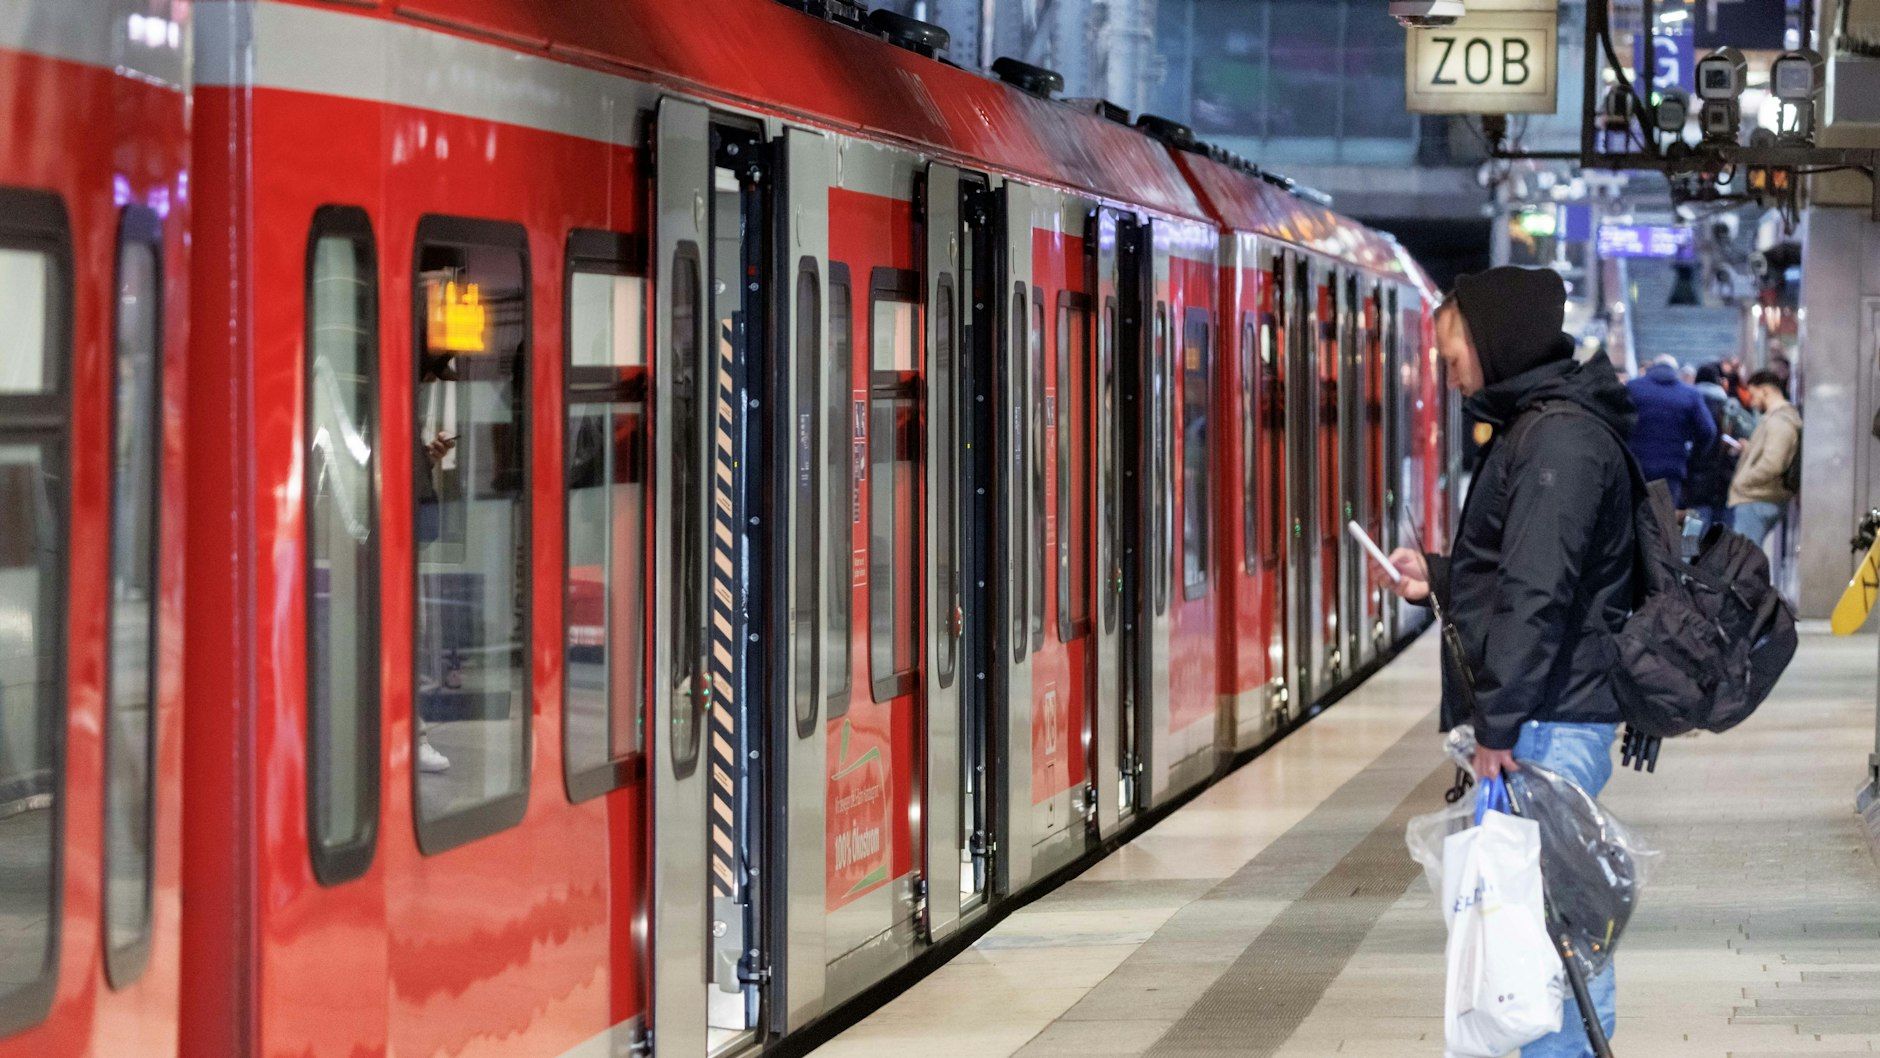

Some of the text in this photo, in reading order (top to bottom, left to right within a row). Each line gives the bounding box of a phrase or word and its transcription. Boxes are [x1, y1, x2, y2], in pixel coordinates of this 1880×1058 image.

[1431, 37, 1530, 85] ZOB
[835, 819, 880, 871] 100% Ökostrom
